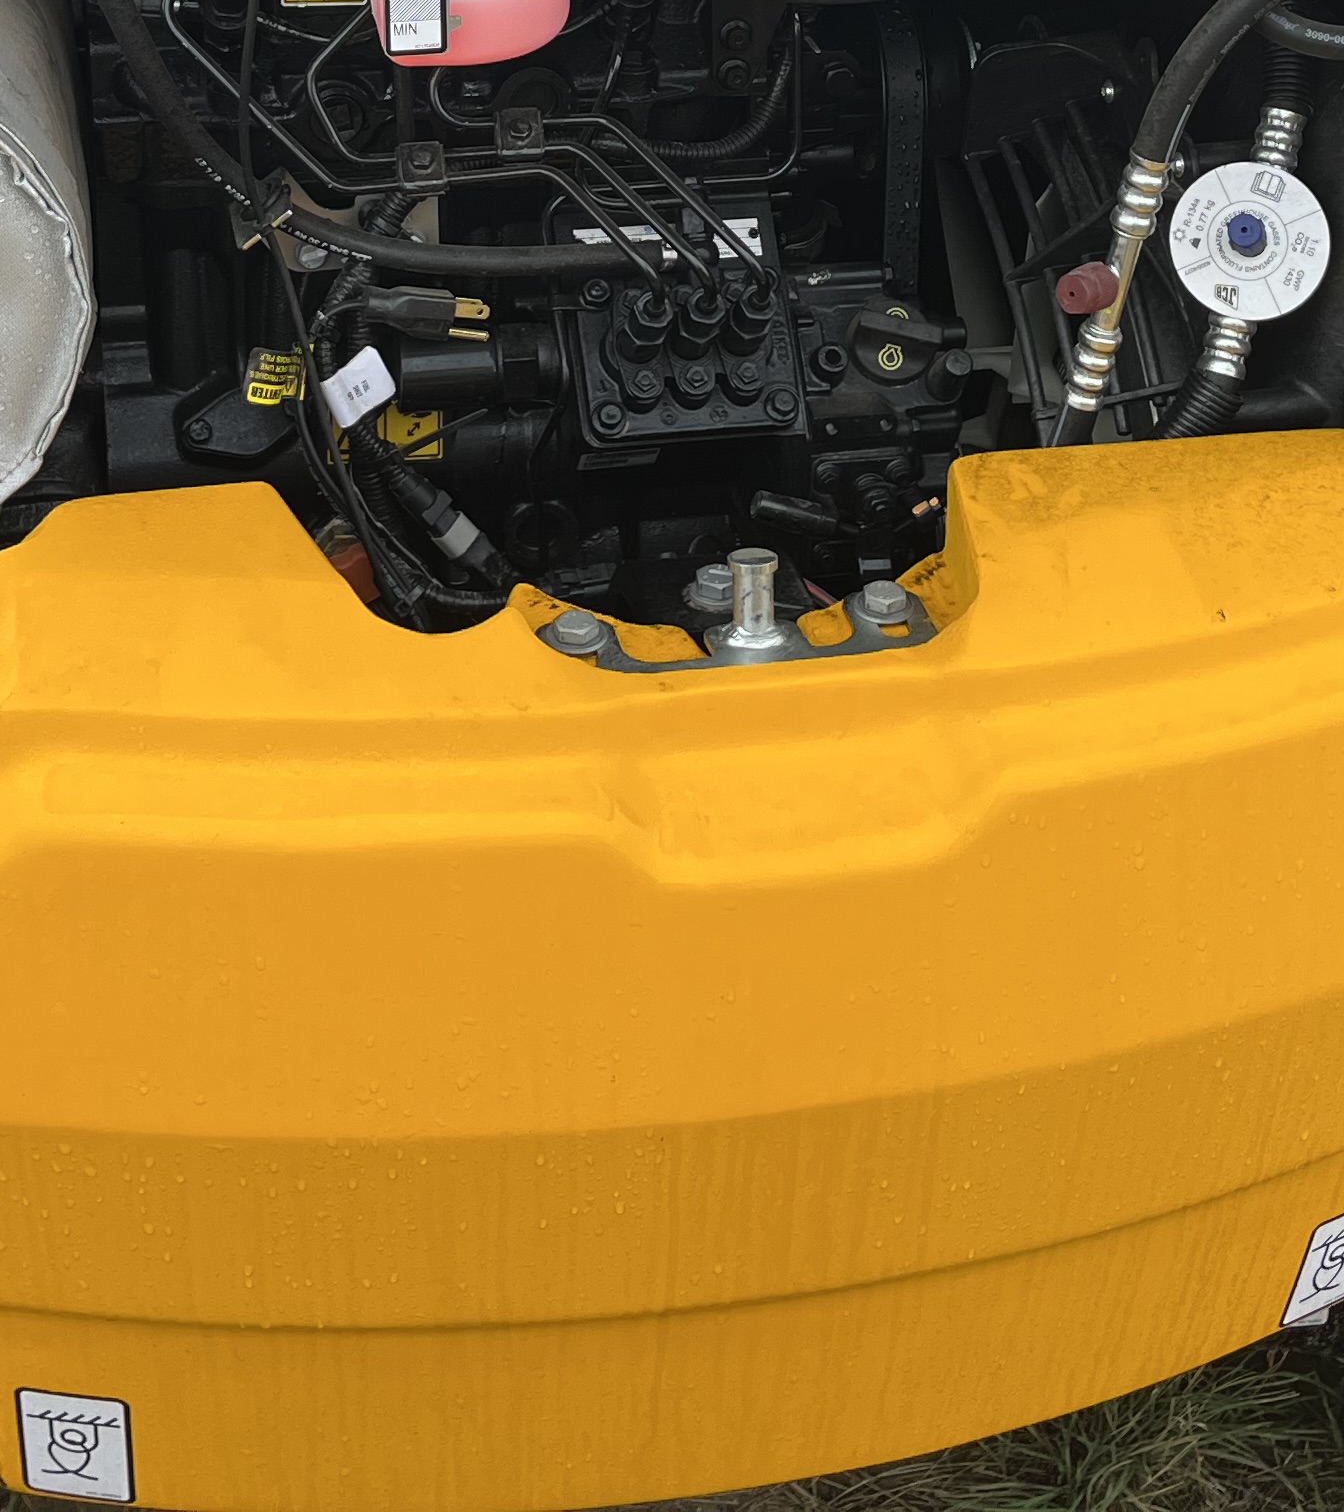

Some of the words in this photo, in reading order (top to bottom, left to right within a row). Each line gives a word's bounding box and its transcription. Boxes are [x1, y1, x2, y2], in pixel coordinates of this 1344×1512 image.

[393, 23, 418, 36] MIN
[1183, 198, 1201, 228] R-134a
[1196, 214, 1209, 232] 0.77
[1205, 199, 1216, 213] kg
[1244, 251, 1278, 273] CONTAINS
[1267, 220, 1281, 246] GASES
[1283, 267, 1296, 287] 1430
[1294, 269, 1305, 292] GWP
[1216, 285, 1237, 306] JCB
